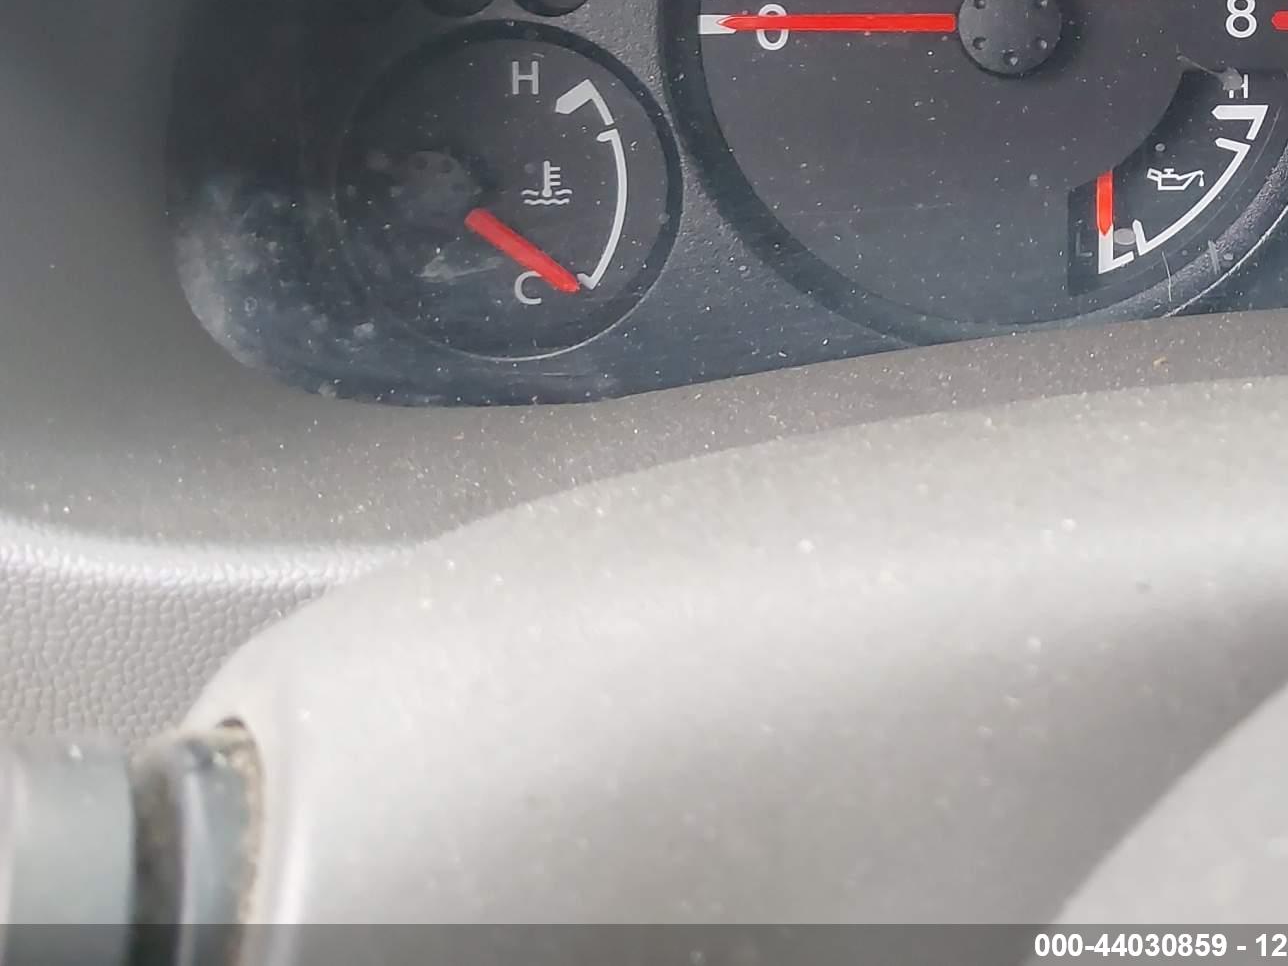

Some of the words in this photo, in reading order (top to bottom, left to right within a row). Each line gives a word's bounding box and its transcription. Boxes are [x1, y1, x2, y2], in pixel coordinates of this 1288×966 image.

[756, 3, 790, 51] 0
[511, 61, 540, 95] H
[514, 270, 543, 305] C
